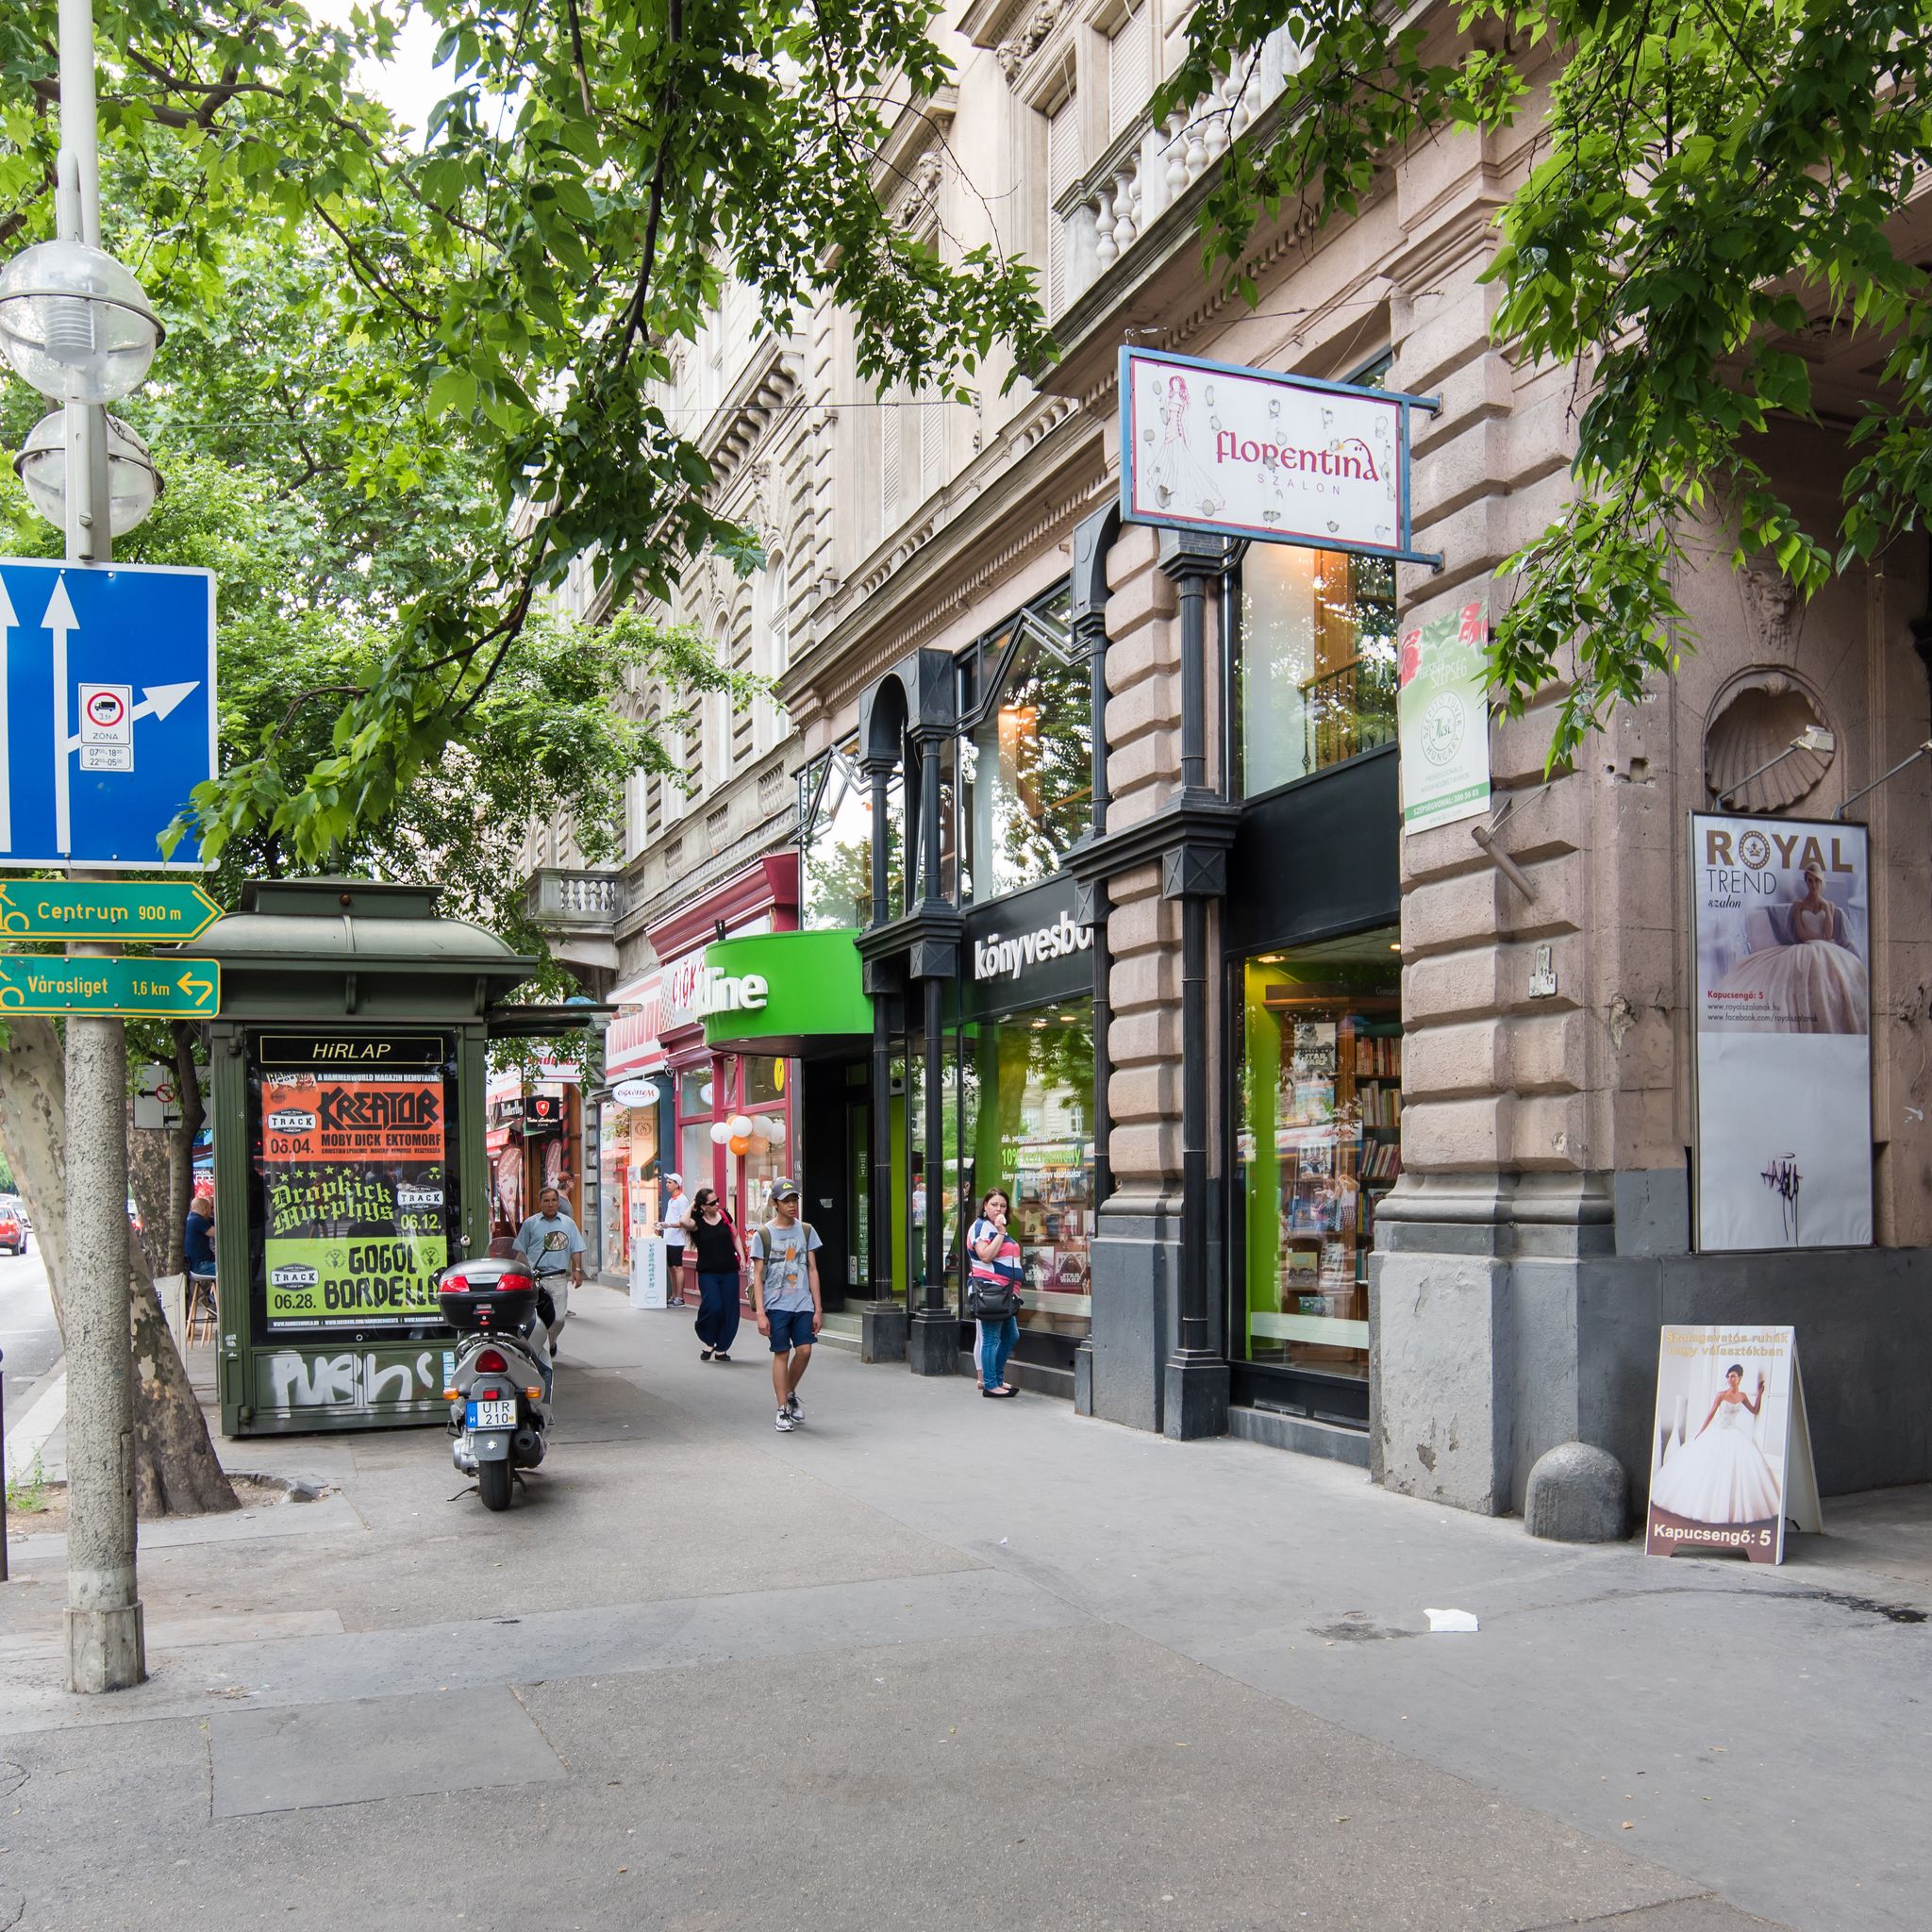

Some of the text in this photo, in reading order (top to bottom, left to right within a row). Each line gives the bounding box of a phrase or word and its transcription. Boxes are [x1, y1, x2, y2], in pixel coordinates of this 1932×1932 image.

[1257, 474, 1341, 495] SZALON
[1426, 734, 1459, 761] HUNGARY
[1706, 829, 1854, 874] ROYAL
[1706, 869, 1777, 895] TREND
[1707, 894, 1741, 908] szalon
[38, 902, 181, 921] Centrum 900 m
[974, 910, 1093, 981] könyvesbo
[27, 974, 108, 998] Városliget
[151, 981, 170, 996] km
[1707, 990, 1756, 1001] Kapucsengő:
[375, 1074, 403, 1082] MAGAZIN
[316, 1086, 440, 1131] KREATOR
[272, 1117, 312, 1126] TRACK
[271, 1138, 314, 1155] 06.04.
[322, 1134, 441, 1146] MOBY DICK EKTOMORF
[271, 1175, 392, 1210] Dropkick
[401, 1193, 440, 1202] TRACK
[274, 1196, 394, 1236] Murphys
[400, 1213, 441, 1230] 06.12.
[348, 1242, 417, 1274] GOGOL
[275, 1273, 315, 1281] TRACK
[275, 1293, 317, 1309] 06.28.
[1752, 1332, 1789, 1344] ruhák
[1702, 1344, 1784, 1357] választékban
[482, 1401, 510, 1413] UIR
[485, 1413, 508, 1424] 210
[1654, 1524, 1772, 1547] Kapucsengő: 5
